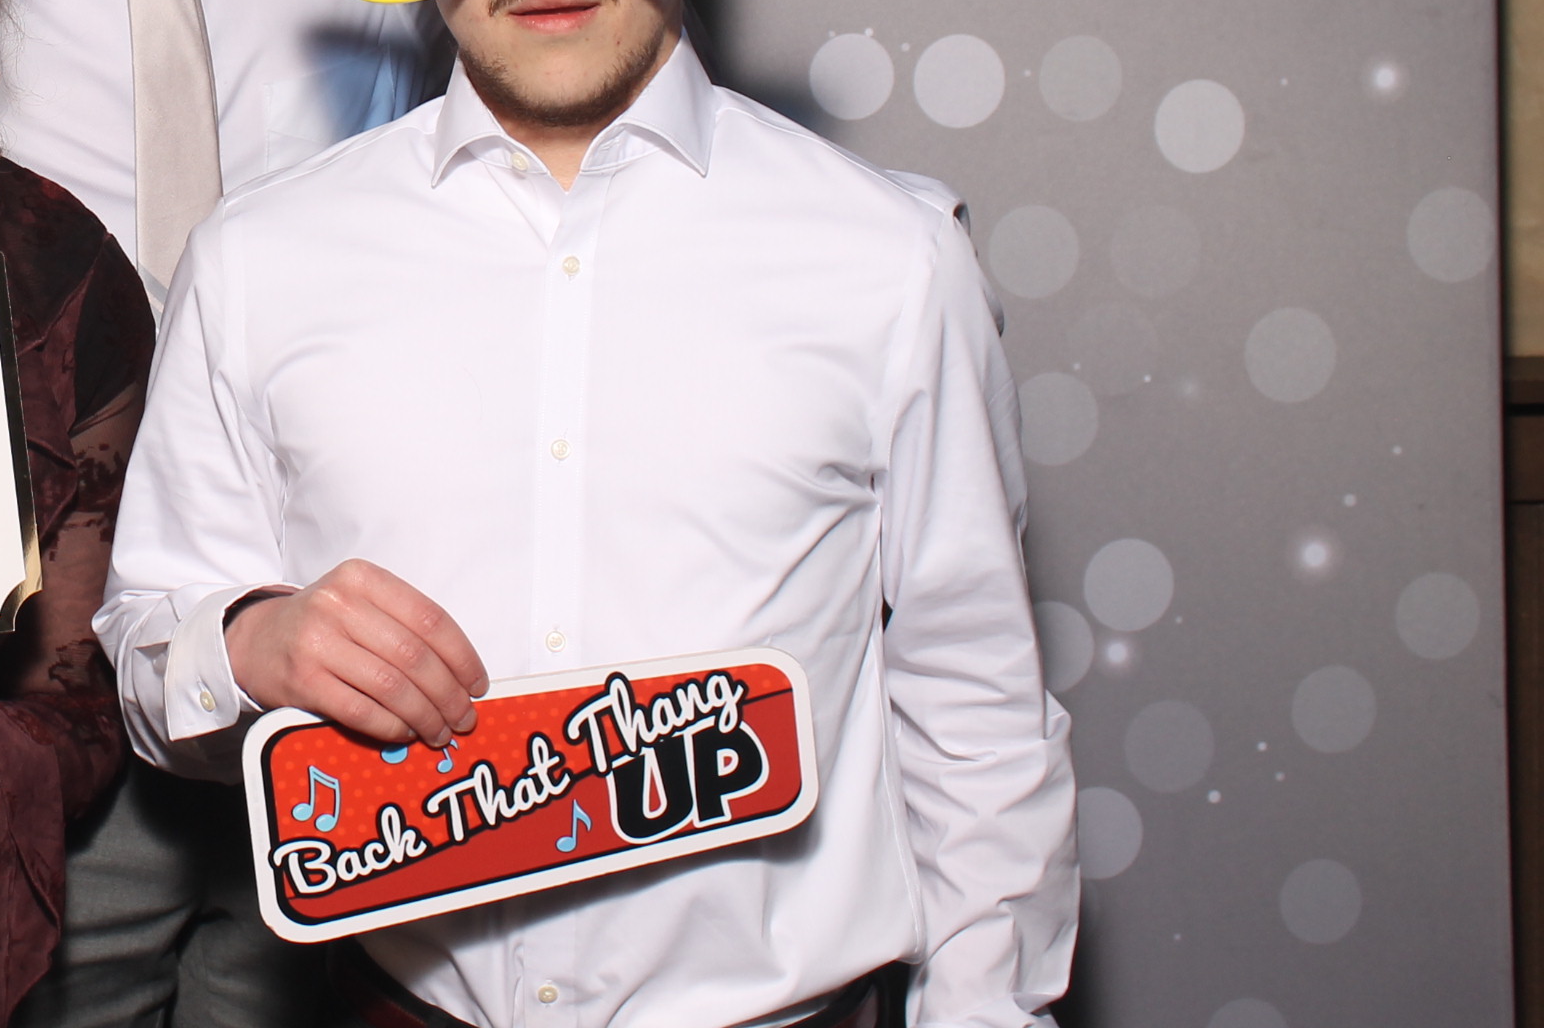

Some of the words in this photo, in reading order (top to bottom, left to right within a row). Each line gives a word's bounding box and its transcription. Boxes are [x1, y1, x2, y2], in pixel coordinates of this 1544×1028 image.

[272, 806, 428, 896] Back
[426, 735, 571, 842] That
[566, 674, 745, 773] Thang
[607, 716, 769, 845] UP
